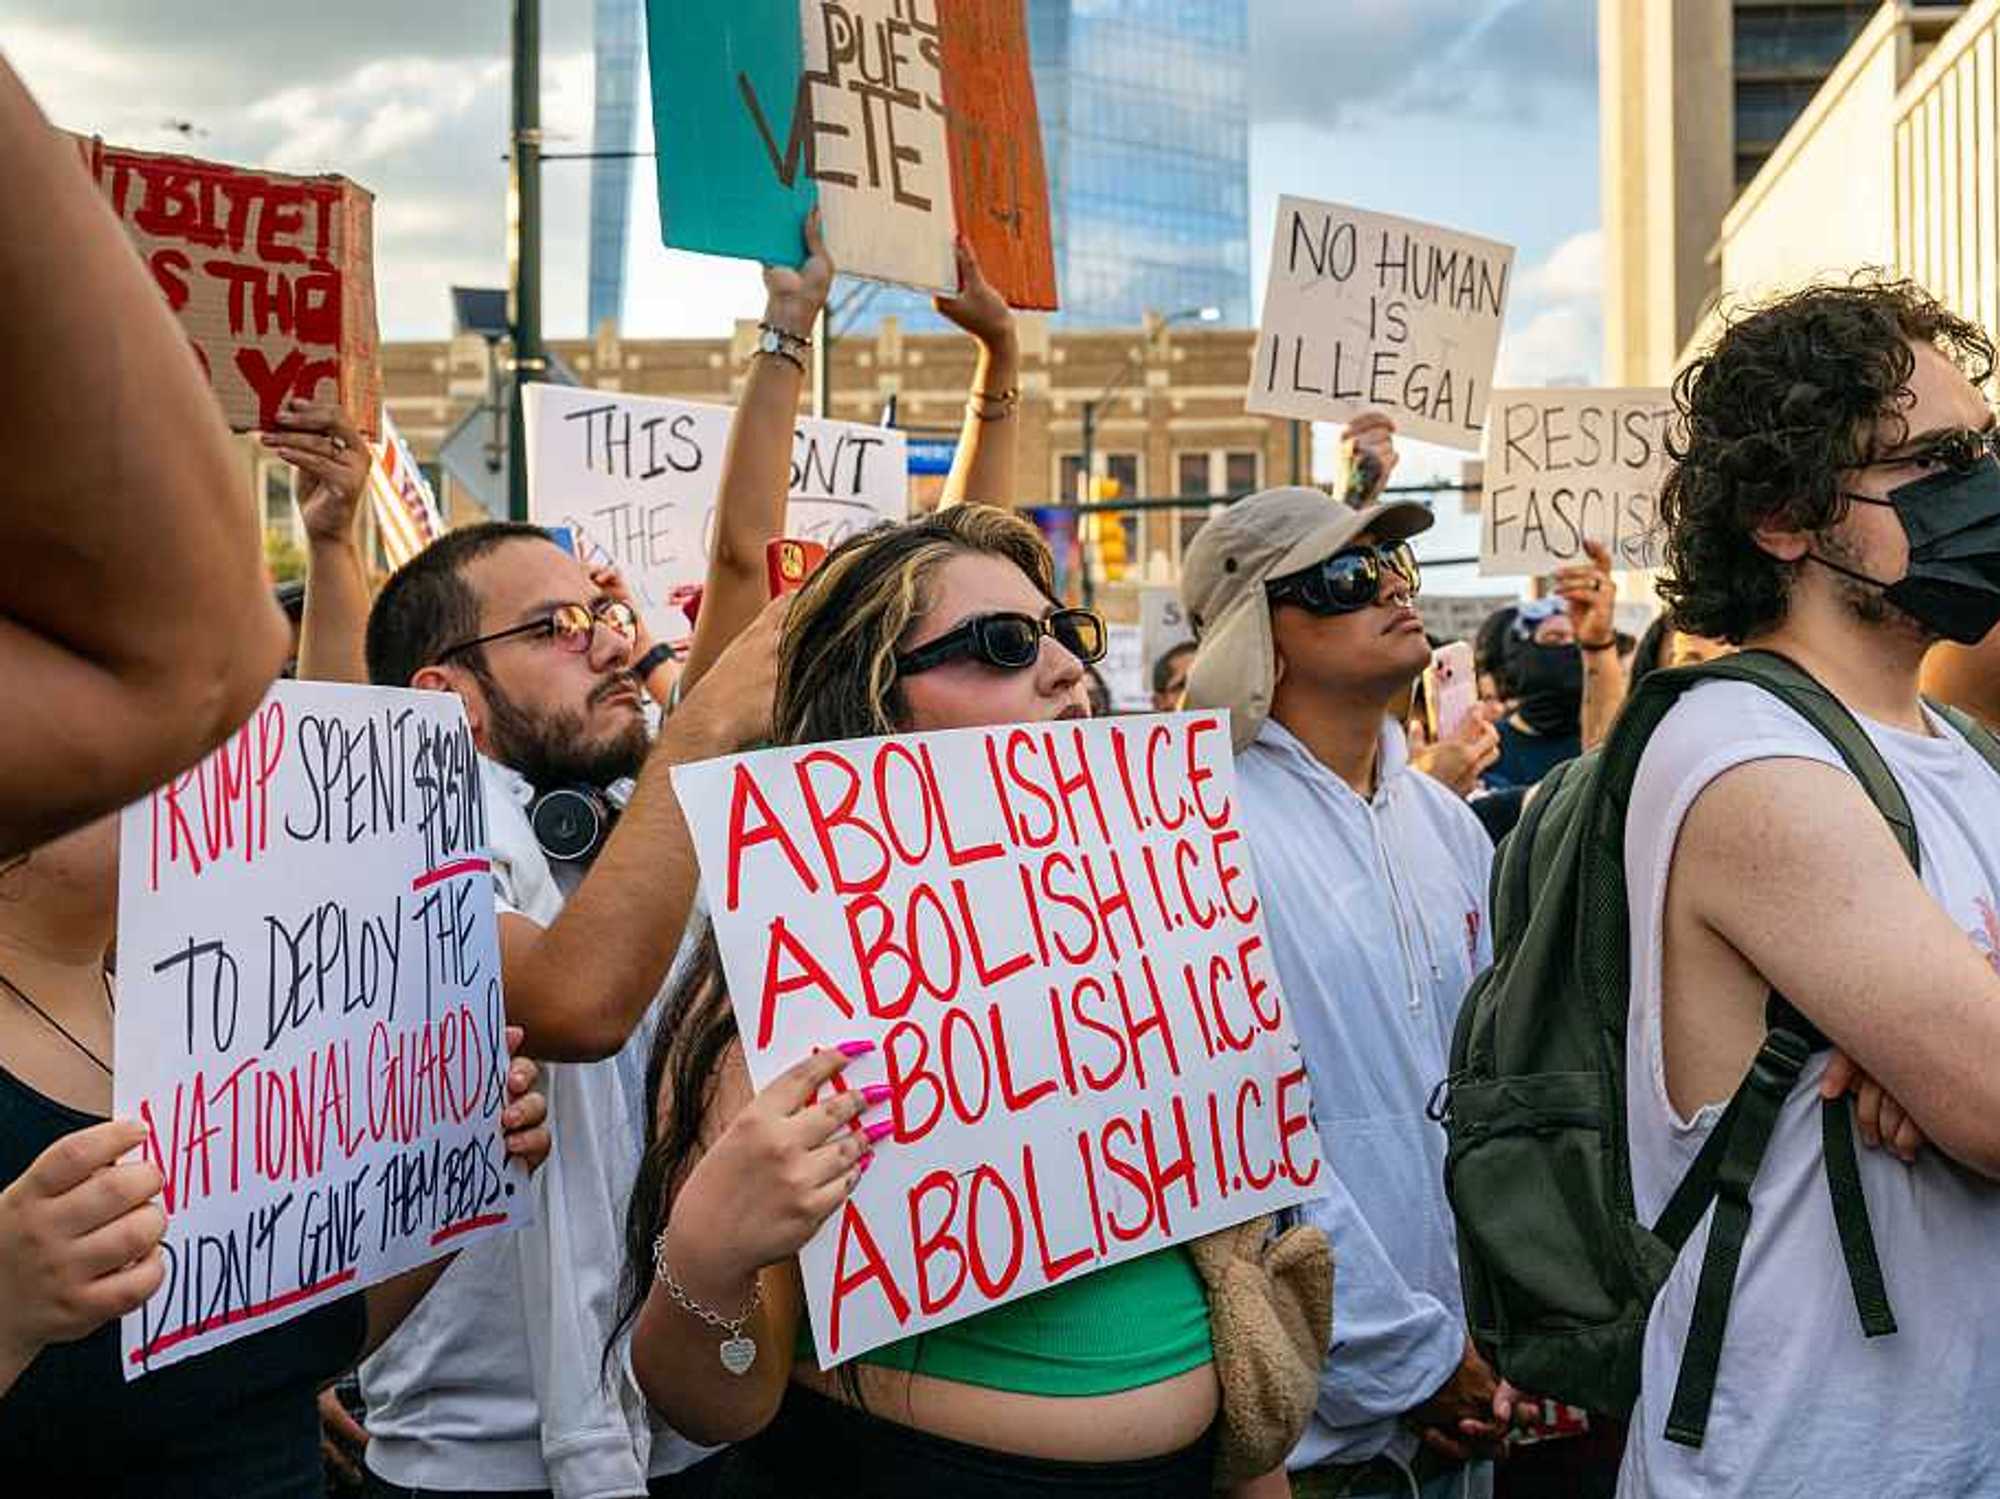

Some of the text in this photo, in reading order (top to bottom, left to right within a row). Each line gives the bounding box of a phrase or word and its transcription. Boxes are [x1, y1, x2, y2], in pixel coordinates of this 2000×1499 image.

[738, 71, 932, 212] VETE
[1290, 210, 1507, 318] NO HUMAN
[1369, 296, 1408, 343] IS
[564, 404, 703, 480] THIS
[1267, 333, 1484, 431] ILLEGAL
[592, 502, 677, 572] THE
[285, 708, 414, 844] SPENT
[727, 719, 1231, 911] ABOLISH I.C.E
[154, 878, 480, 1056] TO DEPLOY THE
[757, 830, 1260, 1051] ABOLISH I.C.E
[1184, 936, 1282, 1059] I.C.E
[140, 1037, 366, 1216] NATIONAL
[368, 1002, 483, 1145] GUARD
[299, 1165, 371, 1290] GIVE
[376, 1139, 441, 1253] THEM
[829, 1068, 1320, 1355] ABOLISH I.C.E
